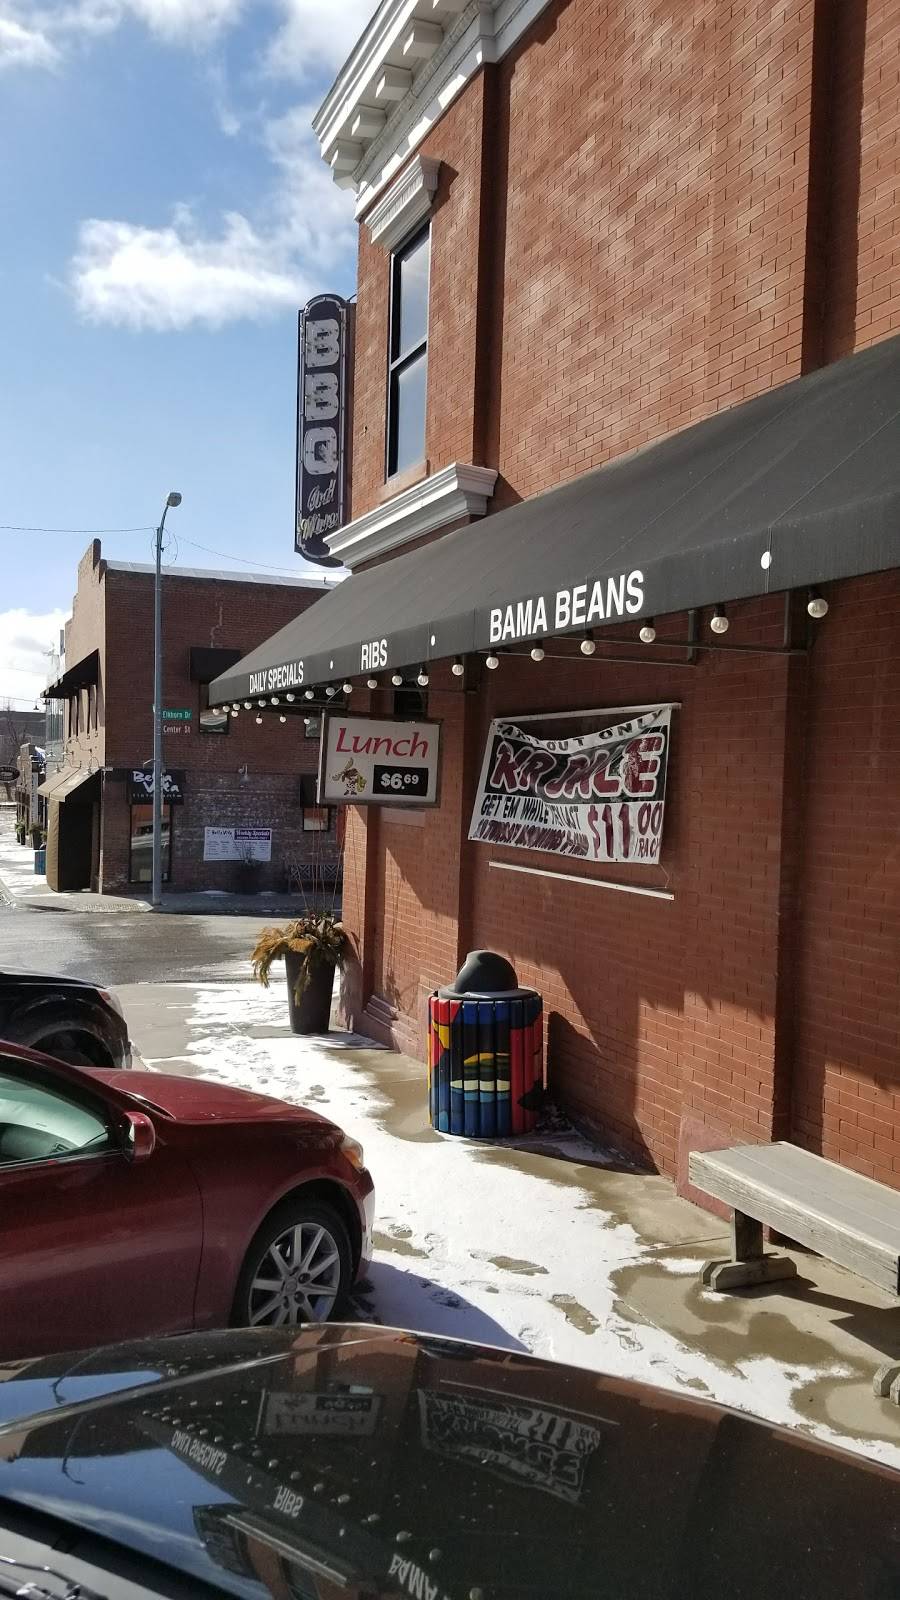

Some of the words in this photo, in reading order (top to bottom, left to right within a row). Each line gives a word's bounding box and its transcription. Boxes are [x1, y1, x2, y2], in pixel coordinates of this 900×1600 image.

[303, 318, 341, 475] BBQ
[489, 596, 548, 643] BAMA
[554, 569, 644, 629] BEANS
[360, 638, 388, 670] RIBS
[249, 671, 267, 694] DAILY
[267, 660, 304, 690] SPECIALS
[162, 710, 183, 719] Elkhorn
[163, 725, 182, 733] Center
[598, 709, 663, 740] ONLY
[335, 727, 429, 758] Lunch
[132, 770, 173, 783] Bea
[143, 781, 180, 793] Vta
[480, 794, 502, 817] GET
[503, 796, 521, 819] EM
[520, 797, 549, 824] WHILE
